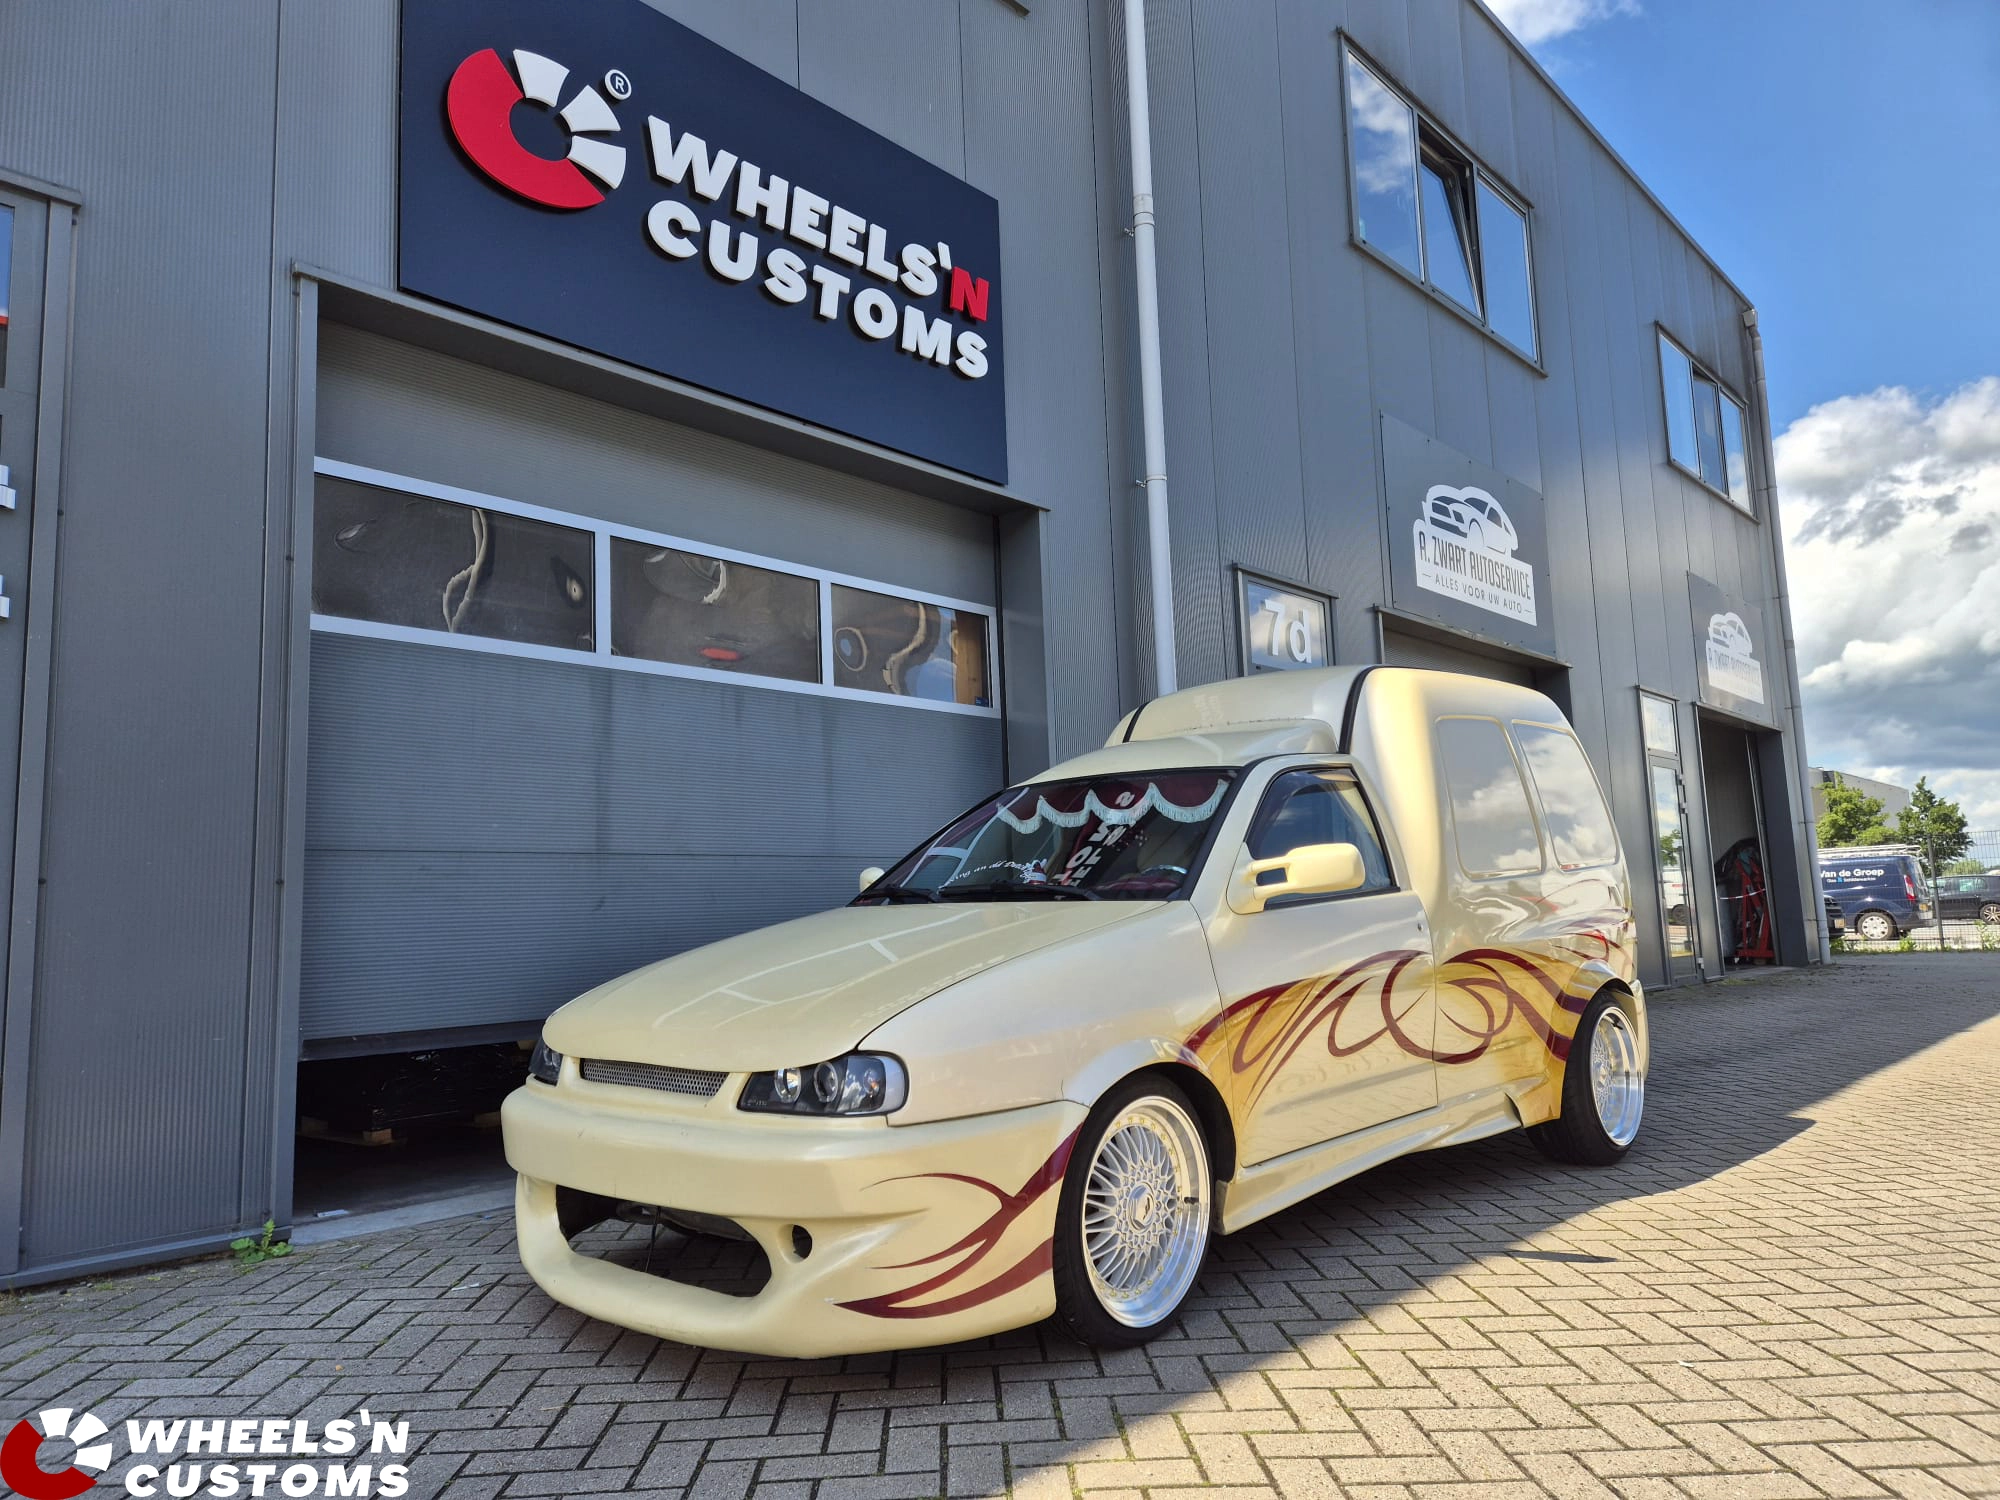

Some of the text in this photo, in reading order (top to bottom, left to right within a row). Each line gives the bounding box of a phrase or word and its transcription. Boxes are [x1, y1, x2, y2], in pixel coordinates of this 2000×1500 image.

[647, 199, 989, 379] CUSTOMS
[1432, 535, 1467, 577] ZWART
[1469, 550, 1531, 601] AUTOSERVICE
[1435, 574, 1522, 614] ALLES VOOR UW AUTO
[1262, 599, 1312, 664] 7d
[1838, 869, 1851, 877] de
[1853, 868, 1885, 877] Groep
